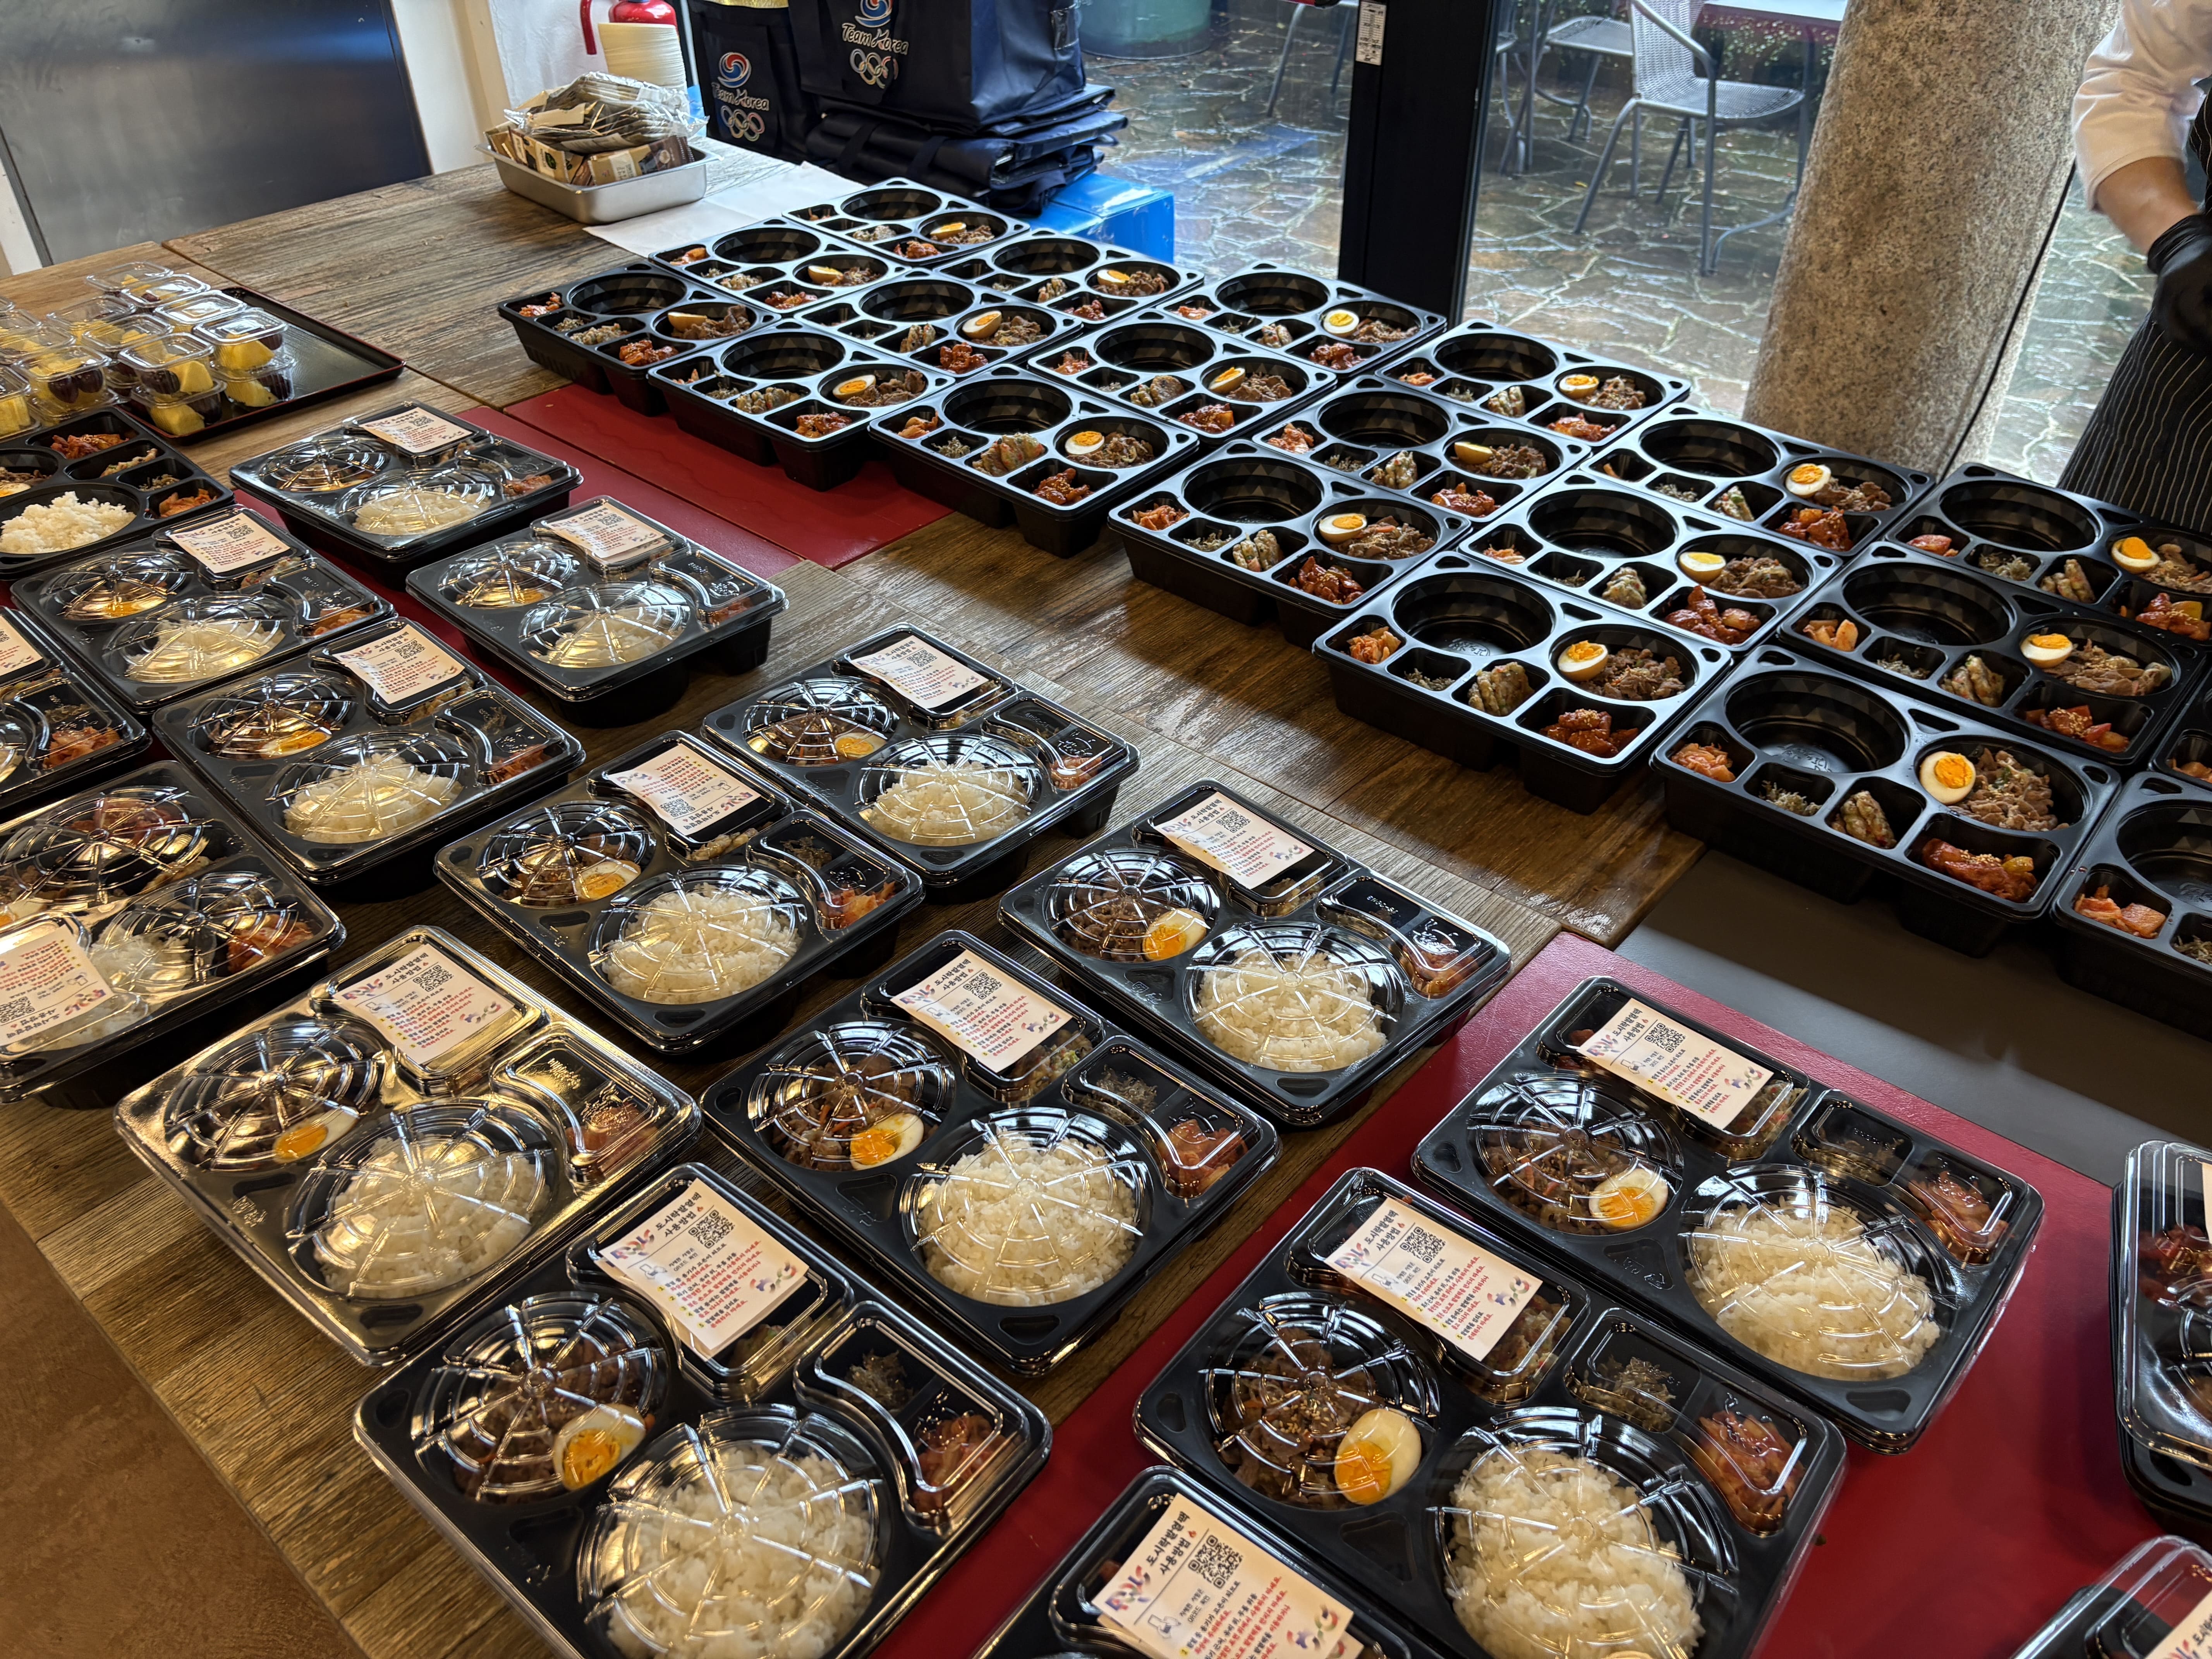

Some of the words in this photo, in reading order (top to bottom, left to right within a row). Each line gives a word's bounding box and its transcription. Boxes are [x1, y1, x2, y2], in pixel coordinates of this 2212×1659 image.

[842, 23, 872, 47] Team
[871, 29, 909, 55] Korea
[734, 89, 769, 111] Korea
[1190, 799, 1223, 820] 도시락발열팩
[1198, 809, 1220, 824] 사용방법
[385, 952, 429, 980] 도시락발열팩
[392, 965, 422, 984] 사용방법
[934, 958, 972, 986] 도시락발열팩
[943, 972, 969, 991] 사용방법
[1612, 1008, 1643, 1037] 도시락발열팩
[1623, 1022, 1645, 1042] 사용방법
[655, 1192, 702, 1231] 도시락발열팩
[665, 1211, 697, 1237] 사용방법
[1364, 1209, 1399, 1245] 도시락발열팩
[1376, 1227, 1401, 1251] 사용방법
[1146, 1511, 1190, 1566] 도시락발열팩
[1159, 1537, 1191, 1575] 사용방법
